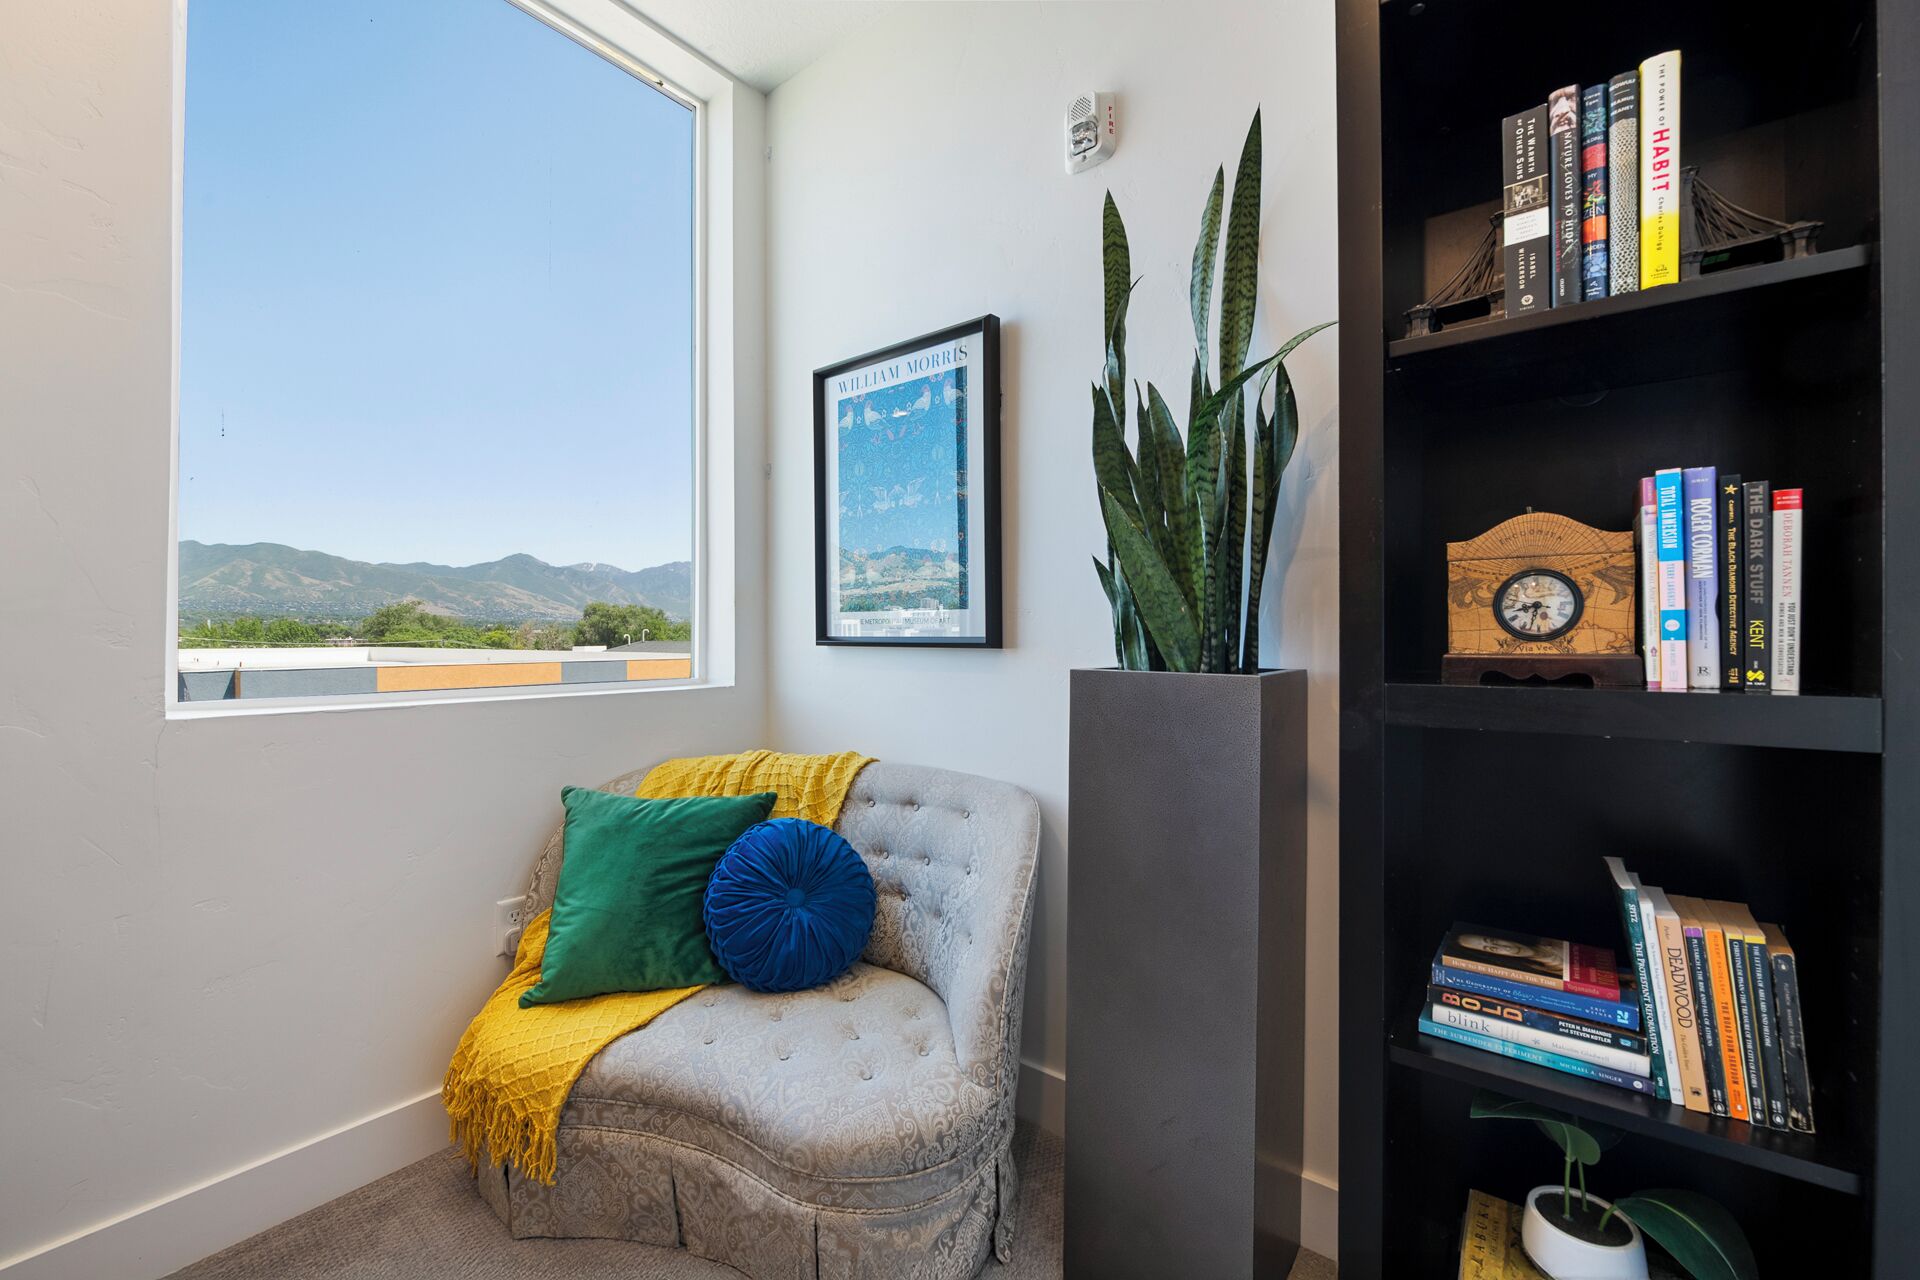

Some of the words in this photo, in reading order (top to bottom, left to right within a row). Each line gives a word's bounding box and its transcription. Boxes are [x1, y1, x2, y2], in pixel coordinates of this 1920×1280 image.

[1527, 118, 1536, 136] THE
[1516, 128, 1524, 155] OTHER
[1564, 131, 1573, 168] NATURE
[1528, 137, 1536, 173] WARMTH
[1516, 158, 1524, 180] SUNS
[1564, 171, 1573, 200] LOVES
[1564, 203, 1574, 216] TO
[1584, 205, 1605, 220] ZEN
[1564, 220, 1574, 245] HIDE
[1518, 248, 1526, 290] WILKERSON
[838, 365, 899, 394] WILLIAM
[906, 344, 968, 374] MORRIS
[1660, 485, 1676, 507] TOTAL
[1750, 485, 1764, 514] THE
[1690, 498, 1712, 532] ROGER
[1660, 509, 1678, 549] IMMERSION
[1728, 528, 1736, 541] THE
[1750, 520, 1764, 559] DARK
[1782, 512, 1793, 556] DEBORAH
[1691, 534, 1713, 579] CORMAN
[1728, 542, 1736, 564] BLACK
[1728, 564, 1736, 594] DIAMOND
[1750, 564, 1764, 604] STUFF
[1782, 560, 1792, 598] TANNEN
[1728, 594, 1737, 628] DETECTIVE
[1788, 602, 1796, 612] YOU
[1788, 614, 1796, 626] JUST
[1729, 630, 1738, 655] AGENCY
[1750, 620, 1764, 650] KENT
[1787, 627, 1796, 642] DON'T
[1786, 642, 1796, 676] UNDERSTAND
[1628, 903, 1638, 923] SPITZ
[1634, 942, 1644, 957] THE
[1692, 938, 1701, 966] PLUTARCH
[1752, 946, 1760, 955] THE
[1488, 967, 1508, 977] HAPPY
[1510, 972, 1524, 980] ALL
[1540, 977, 1556, 986] TIME
[1637, 958, 1651, 1003] PROTESTANT
[1696, 970, 1704, 981] THE
[1754, 956, 1762, 980] LETTERS
[1466, 978, 1502, 990] GEOGRAPHY
[1667, 948, 1693, 1028] DEADWOOD
[1442, 992, 1523, 1022] BOLD
[1758, 988, 1766, 1012] ABELARD
[1448, 1011, 1490, 1033] blink
[1703, 1018, 1710, 1026] OF
[1723, 1016, 1731, 1034] ROAD
[1733, 941, 1742, 969] CHRISTINE
[1741, 1004, 1750, 1030] TREASURE
[1750, 1070, 1758, 1088] LADIES
[1558, 1020, 1576, 1029] PETER
[1582, 1026, 1612, 1038] DIAMANDIS
[1570, 1029, 1590, 1039] STEVEN
[1590, 1034, 1612, 1044] KOTLER
[1644, 1003, 1660, 1055] REFORMATION
[1704, 1026, 1713, 1047] ATHENS
[1451, 1030, 1494, 1049] SURRENDER
[1495, 1043, 1543, 1062] EXPERIMENT
[1726, 1034, 1734, 1052] FROM
[1560, 1062, 1589, 1074] MICHAEL
[1598, 1072, 1623, 1083] SINGER
[1728, 1054, 1738, 1086] SERFDOM
